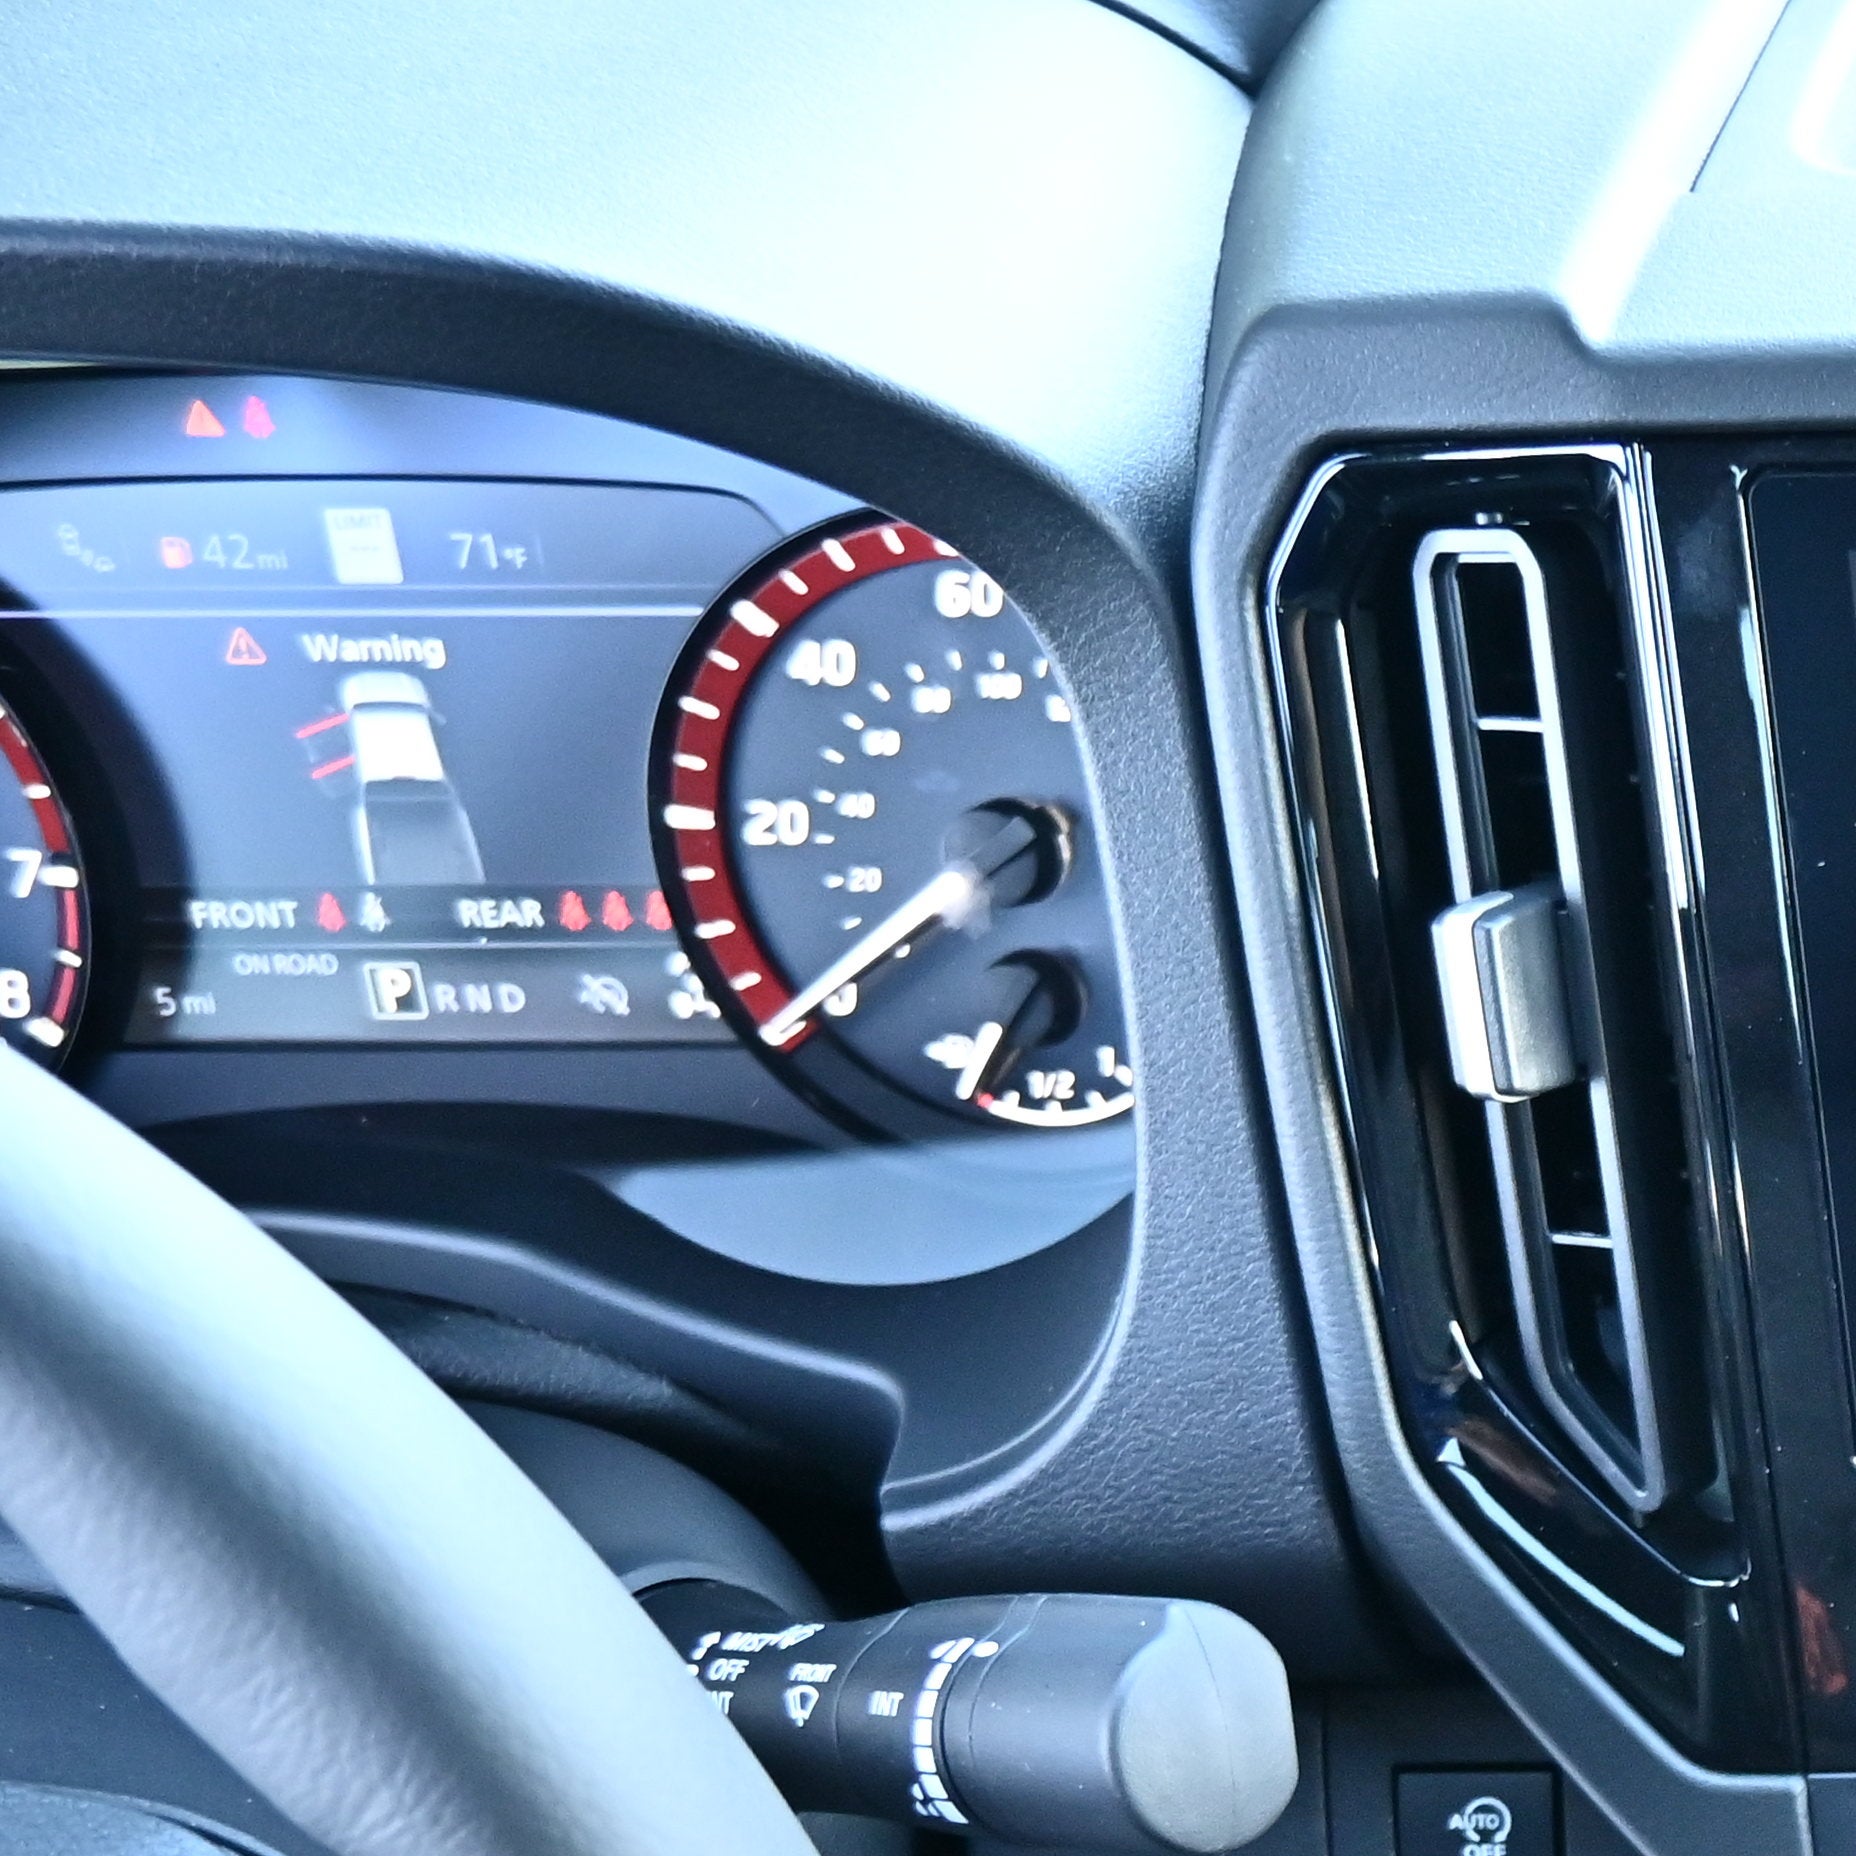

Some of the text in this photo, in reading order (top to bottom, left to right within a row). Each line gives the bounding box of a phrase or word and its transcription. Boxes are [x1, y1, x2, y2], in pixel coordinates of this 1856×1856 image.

[935, 570, 1003, 618] 60
[303, 634, 446, 668] Warning
[787, 640, 856, 686] 40
[742, 800, 809, 845] 20
[7, 847, 42, 898] 7
[190, 901, 298, 930] FRONT
[457, 899, 544, 928] REAR
[233, 953, 339, 977] ON ROAD
[379, 969, 412, 1012] P
[706, 1659, 749, 1681] OFF
[787, 1664, 837, 1683] FRONT
[868, 1691, 904, 1717] INT
